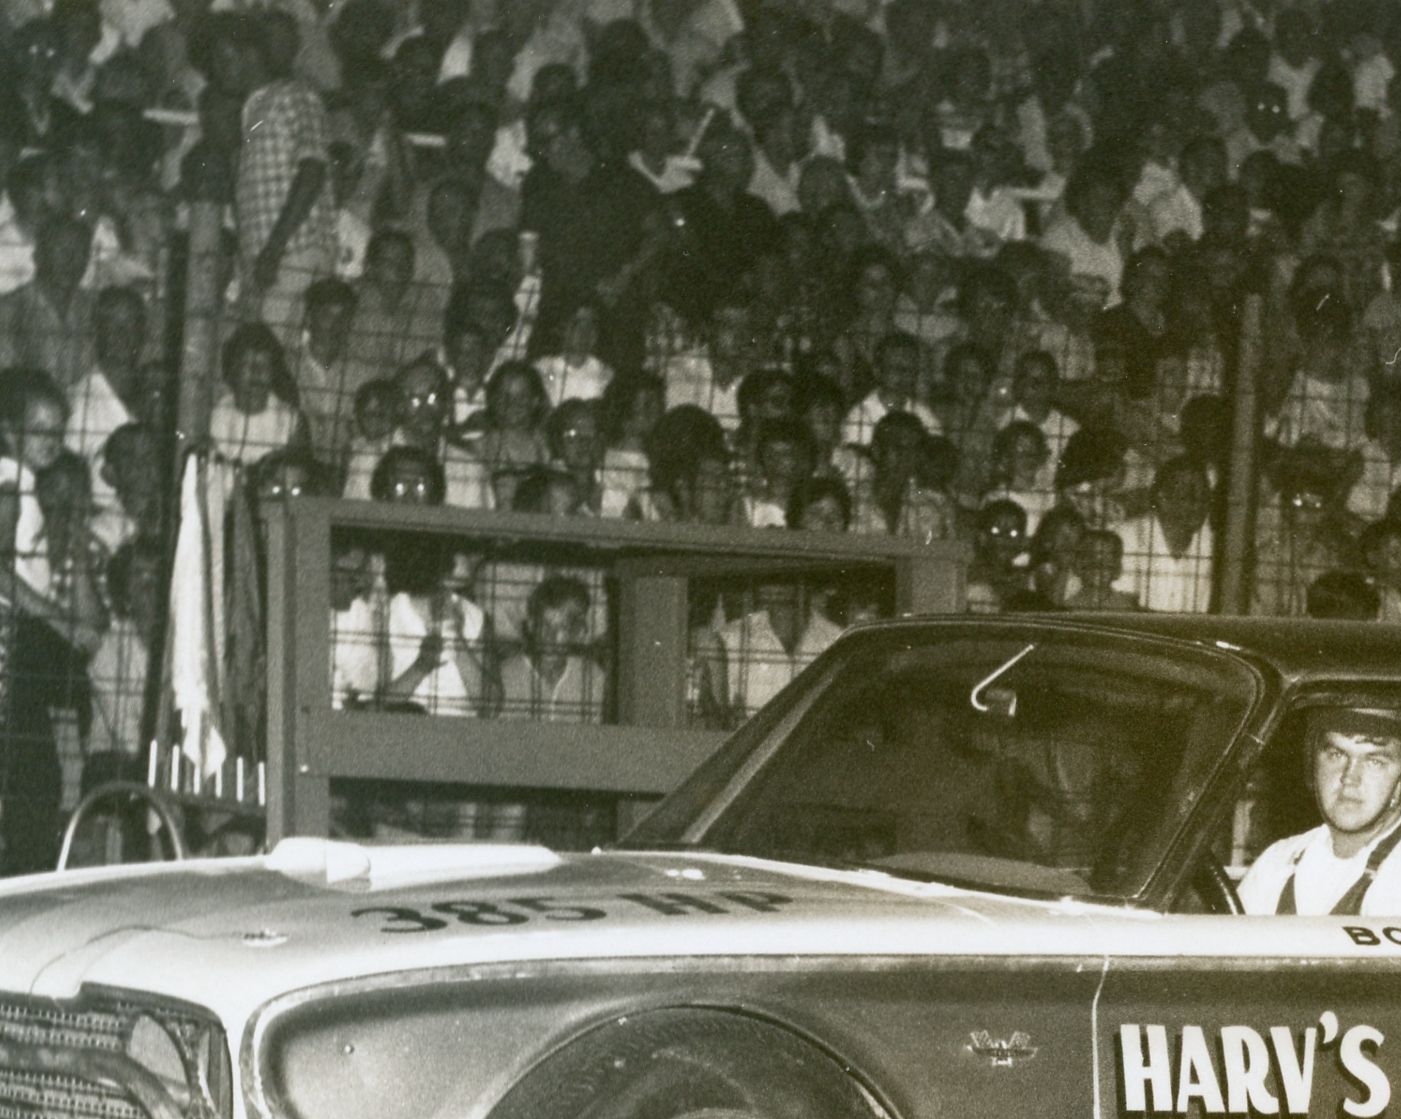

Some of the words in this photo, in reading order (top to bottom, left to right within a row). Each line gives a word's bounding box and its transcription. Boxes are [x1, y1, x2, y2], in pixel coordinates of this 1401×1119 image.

[350, 895, 607, 933] 385
[616, 891, 793, 916] HP
[1119, 1010, 1391, 1118] HARV'S
